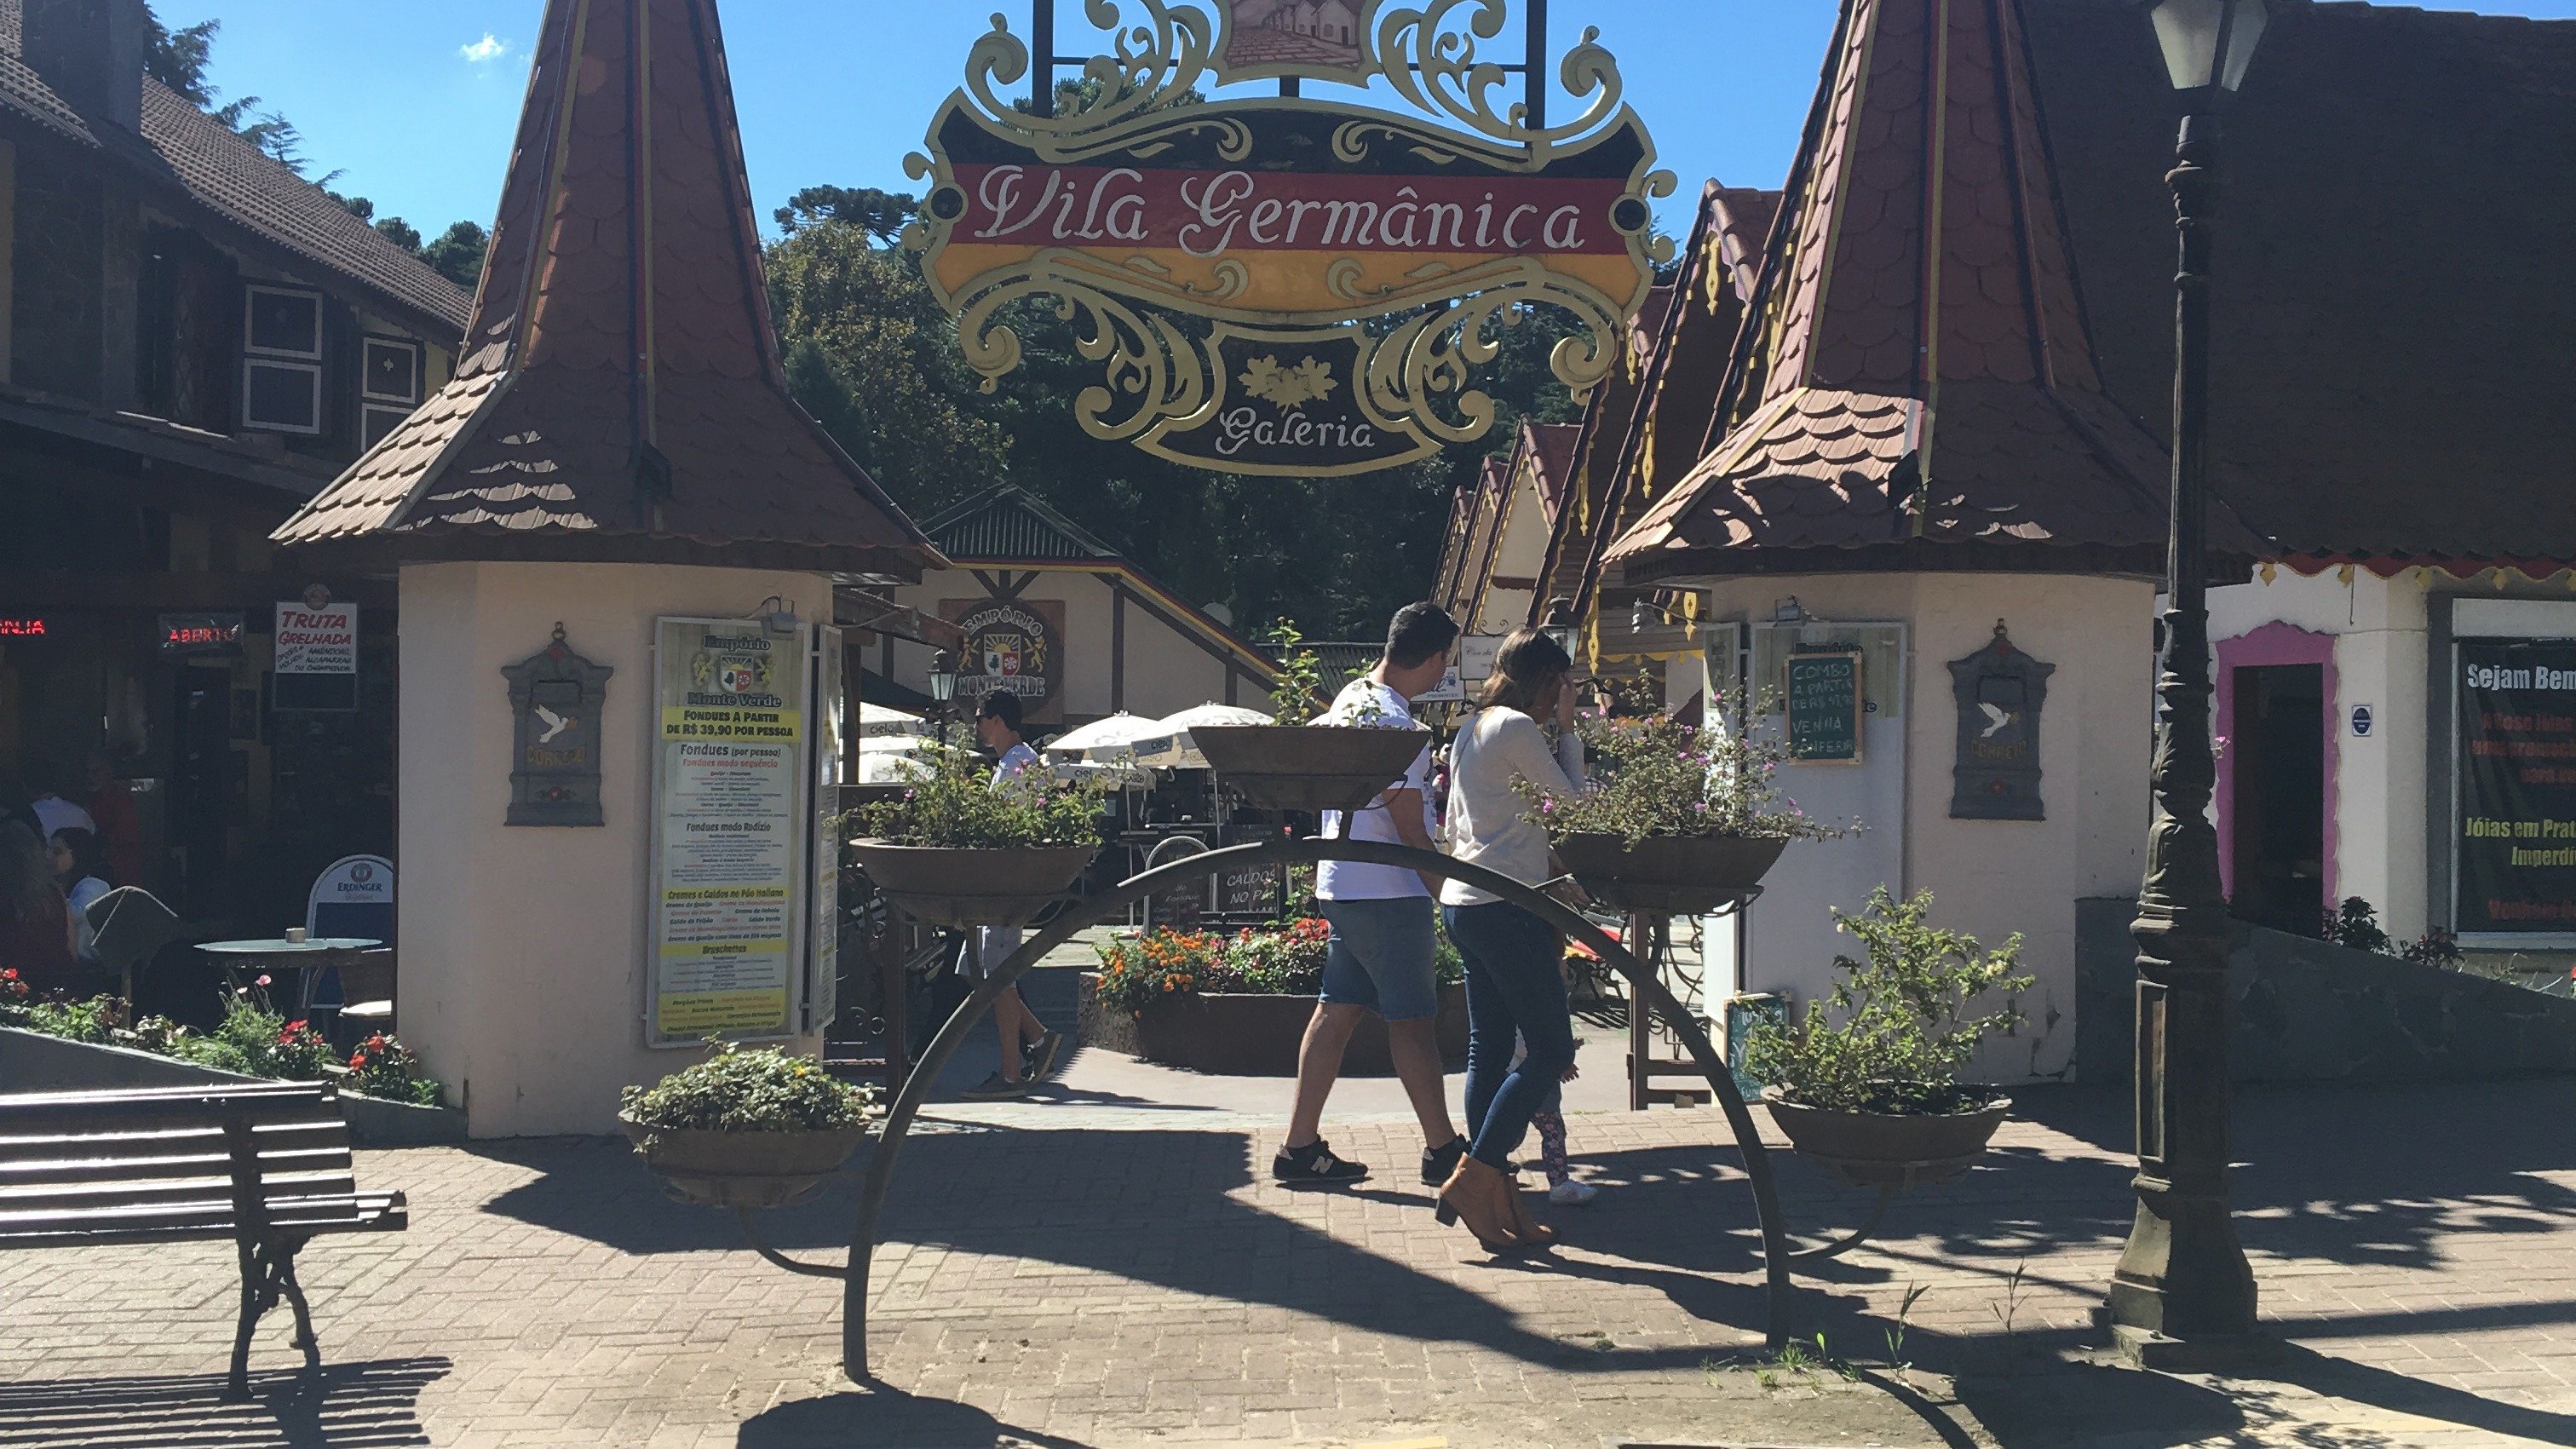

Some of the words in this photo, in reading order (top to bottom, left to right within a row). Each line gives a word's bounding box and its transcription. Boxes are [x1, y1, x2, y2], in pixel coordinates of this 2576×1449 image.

[974, 164, 1148, 242] Vila
[1179, 170, 1585, 258] Germânica
[1215, 406, 1376, 456] Galeria
[281, 610, 348, 630] TRUTA
[961, 605, 1044, 637] EMPÓRIO
[278, 630, 352, 646] GRELHADA
[704, 635, 772, 652] Empório
[1792, 664, 1850, 681] COMBO
[2467, 664, 2530, 691] Sejam
[2534, 665, 2576, 690] Bem
[687, 692, 738, 706] Monte
[738, 694, 783, 708] Verde
[684, 710, 731, 722] FONDUES
[733, 711, 740, 722] A
[744, 712, 779, 723] PARTIR
[666, 724, 681, 733] DE
[683, 722, 698, 735] R$
[734, 727, 755, 736] POR
[756, 727, 793, 737] PESSOA
[681, 744, 729, 756] Fondues
[1074, 768, 1093, 779] ciel
[687, 822, 719, 832] Fondues
[2464, 816, 2511, 837] Jóias
[2514, 821, 2539, 837] em
[2511, 846, 2576, 868] Imperdí
[337, 882, 382, 892] ERDINGER
[1229, 891, 1249, 905] NO
